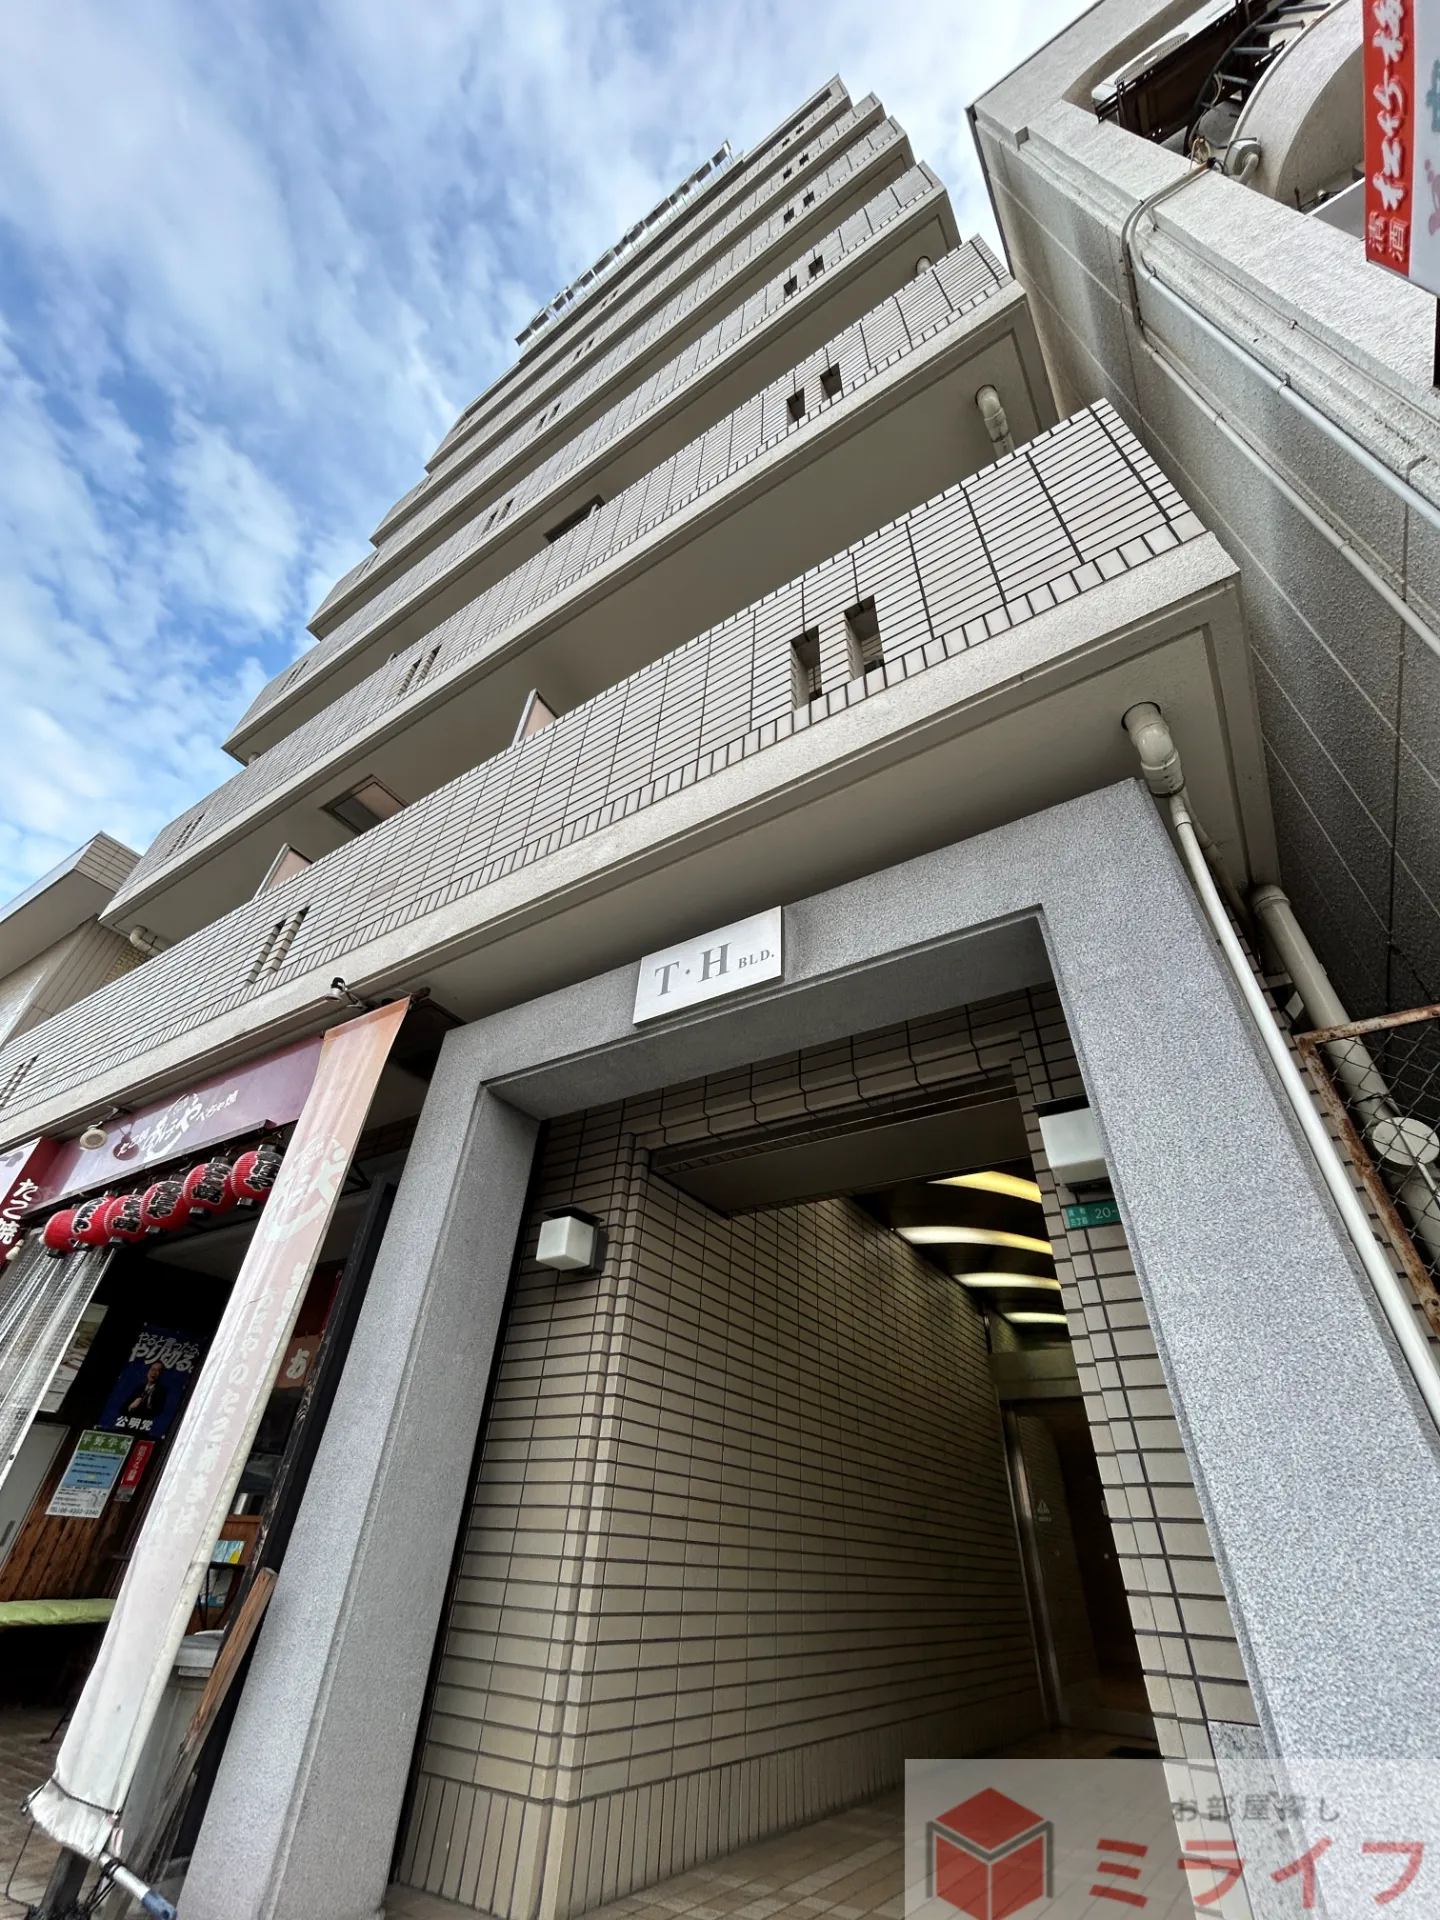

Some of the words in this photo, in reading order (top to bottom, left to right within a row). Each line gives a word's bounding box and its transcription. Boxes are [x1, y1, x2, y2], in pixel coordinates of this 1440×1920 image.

[738, 949, 775, 970] BLD.
[0, 1178, 38, 1245] たこ焼
[115, 1416, 154, 1431] 公明党
